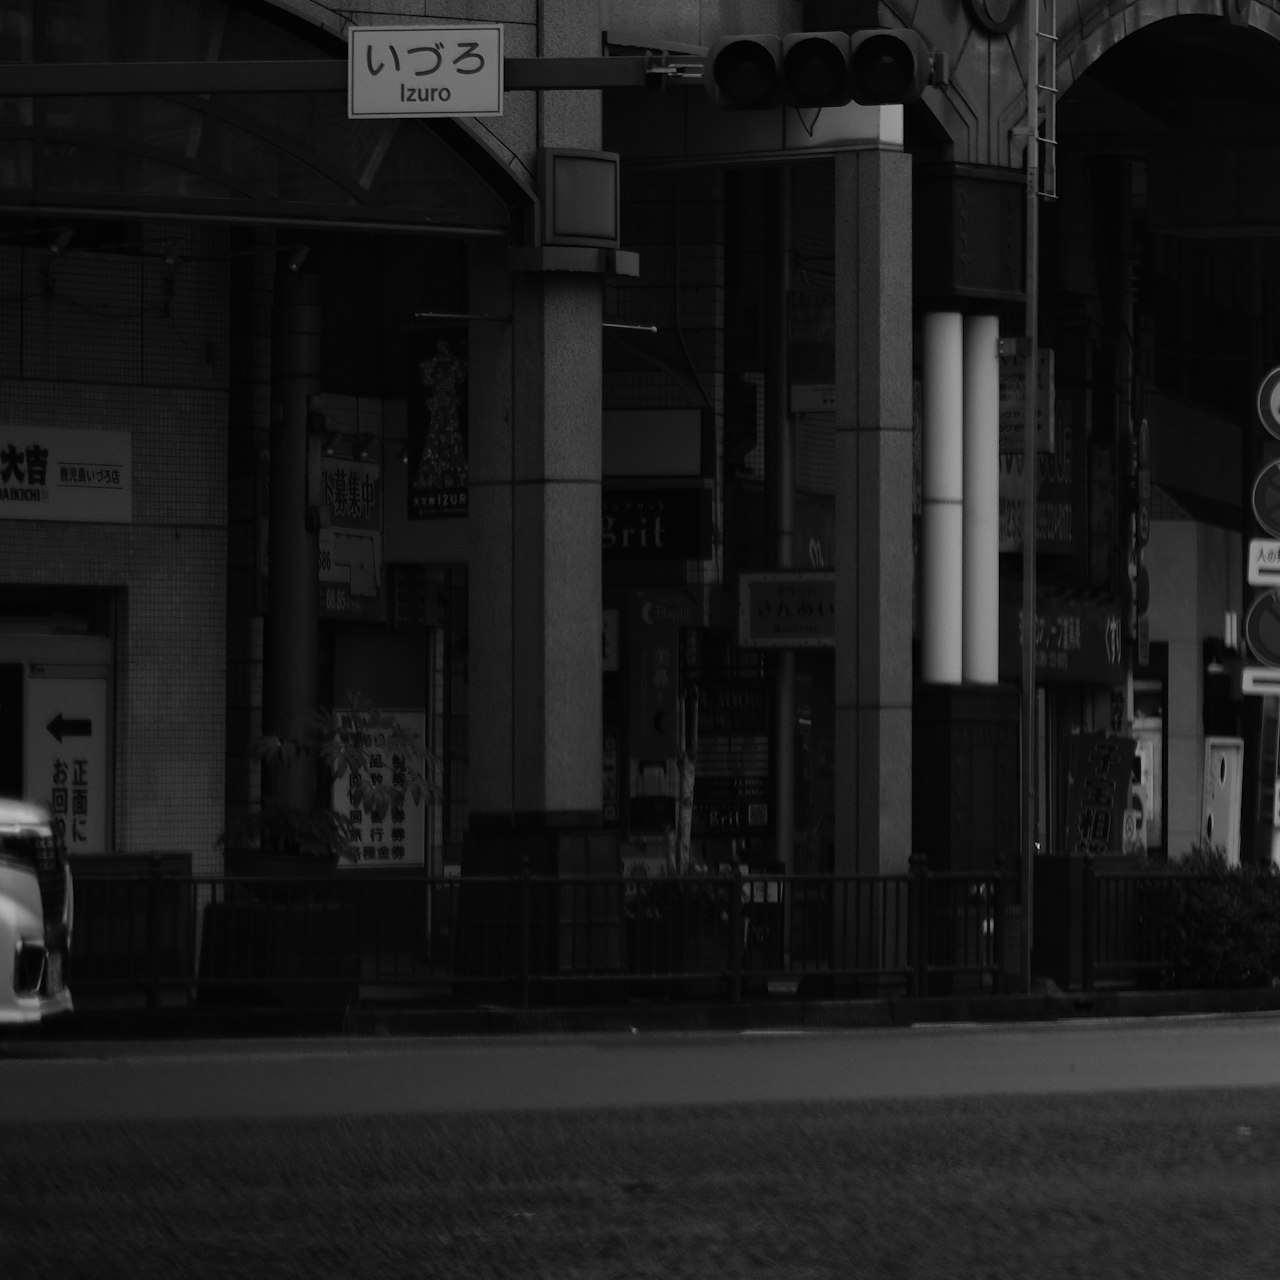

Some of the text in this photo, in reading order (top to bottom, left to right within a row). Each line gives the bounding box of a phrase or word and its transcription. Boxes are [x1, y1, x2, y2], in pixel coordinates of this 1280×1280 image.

[366, 42, 486, 77] いづろ
[401, 83, 451, 102] Izuro
[1, 444, 48, 486] 大吉
[437, 493, 467, 507] IZUR
[72, 760, 88, 842] 正面に
